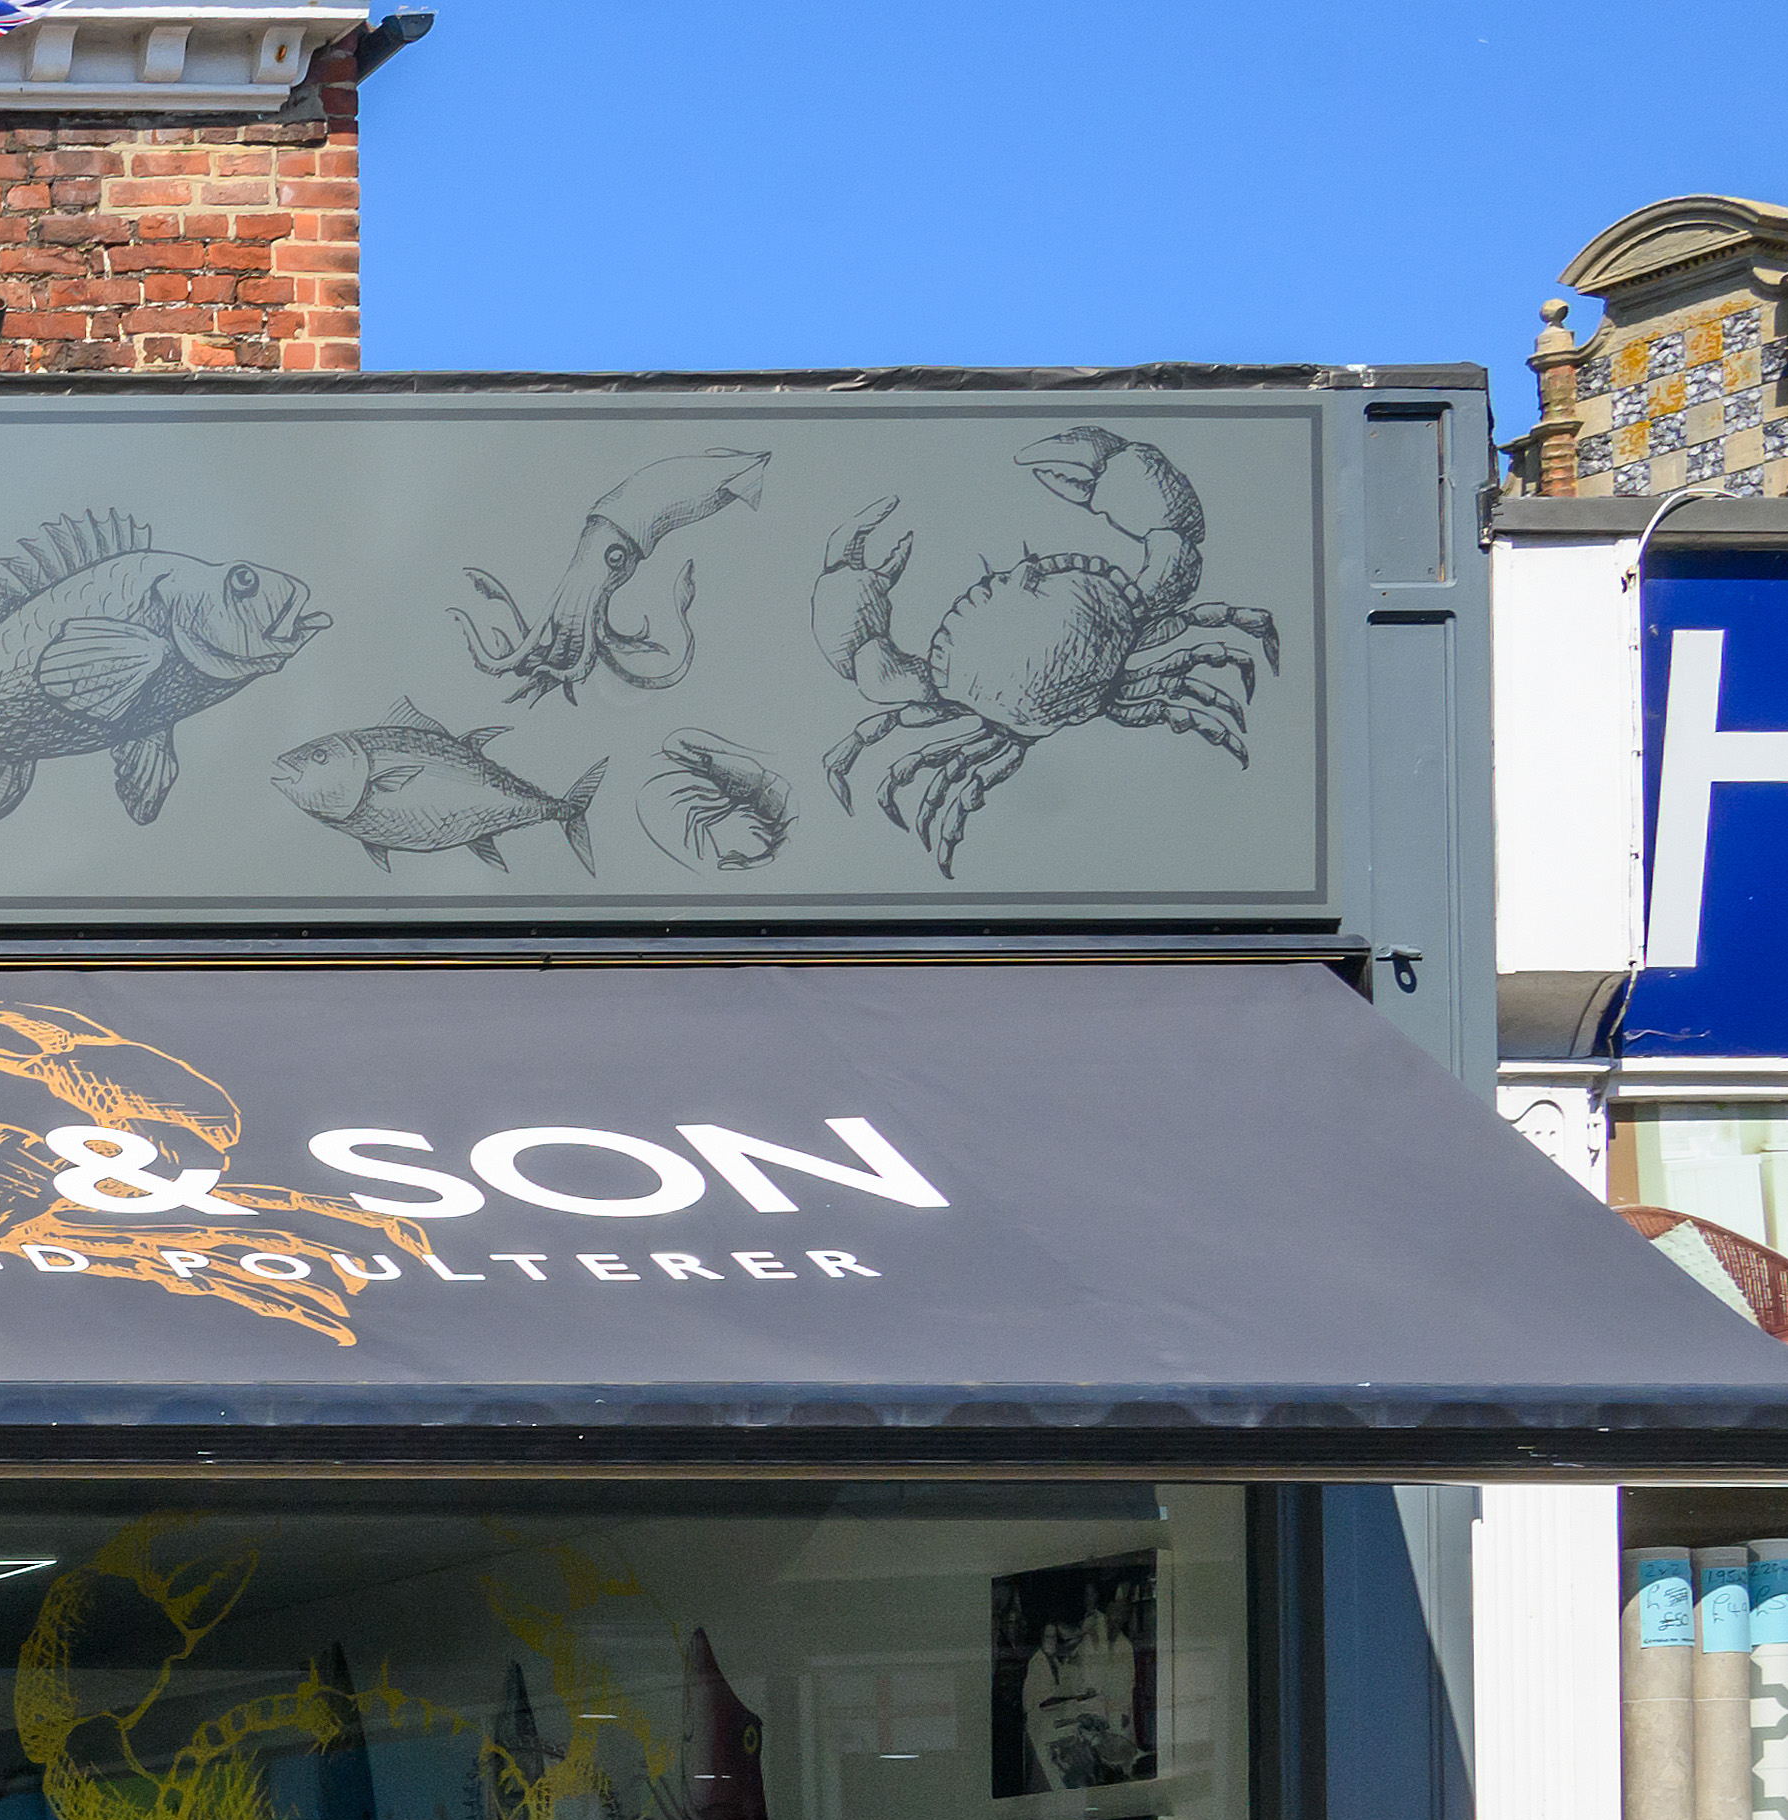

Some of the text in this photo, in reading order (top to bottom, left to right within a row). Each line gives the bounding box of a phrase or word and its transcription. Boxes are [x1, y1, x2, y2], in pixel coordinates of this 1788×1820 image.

[44, 1125, 260, 1217] &
[307, 1117, 951, 1220] SON
[168, 1248, 883, 1283] POULTERER
